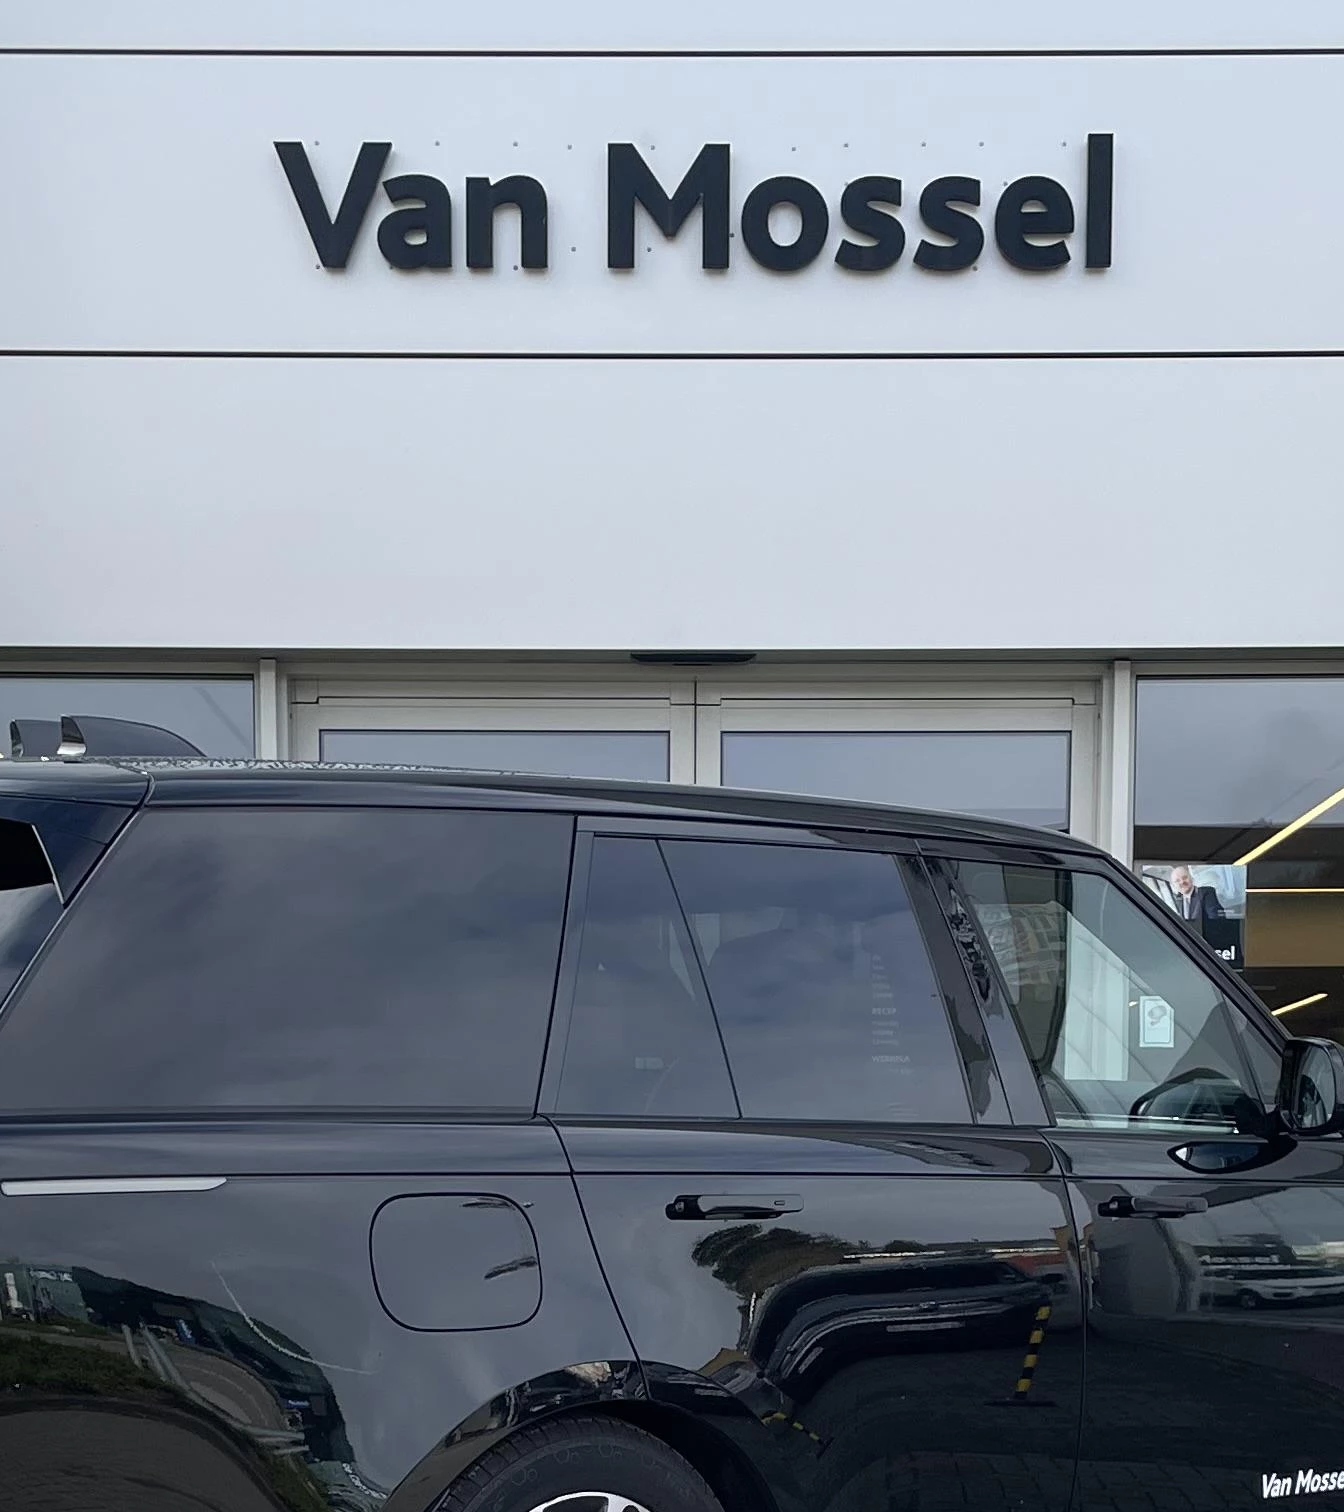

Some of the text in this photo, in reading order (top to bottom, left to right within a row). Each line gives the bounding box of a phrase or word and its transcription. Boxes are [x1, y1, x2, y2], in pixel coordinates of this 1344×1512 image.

[273, 132, 1115, 272] Van Mossel
[1262, 1472, 1292, 1499] Van
